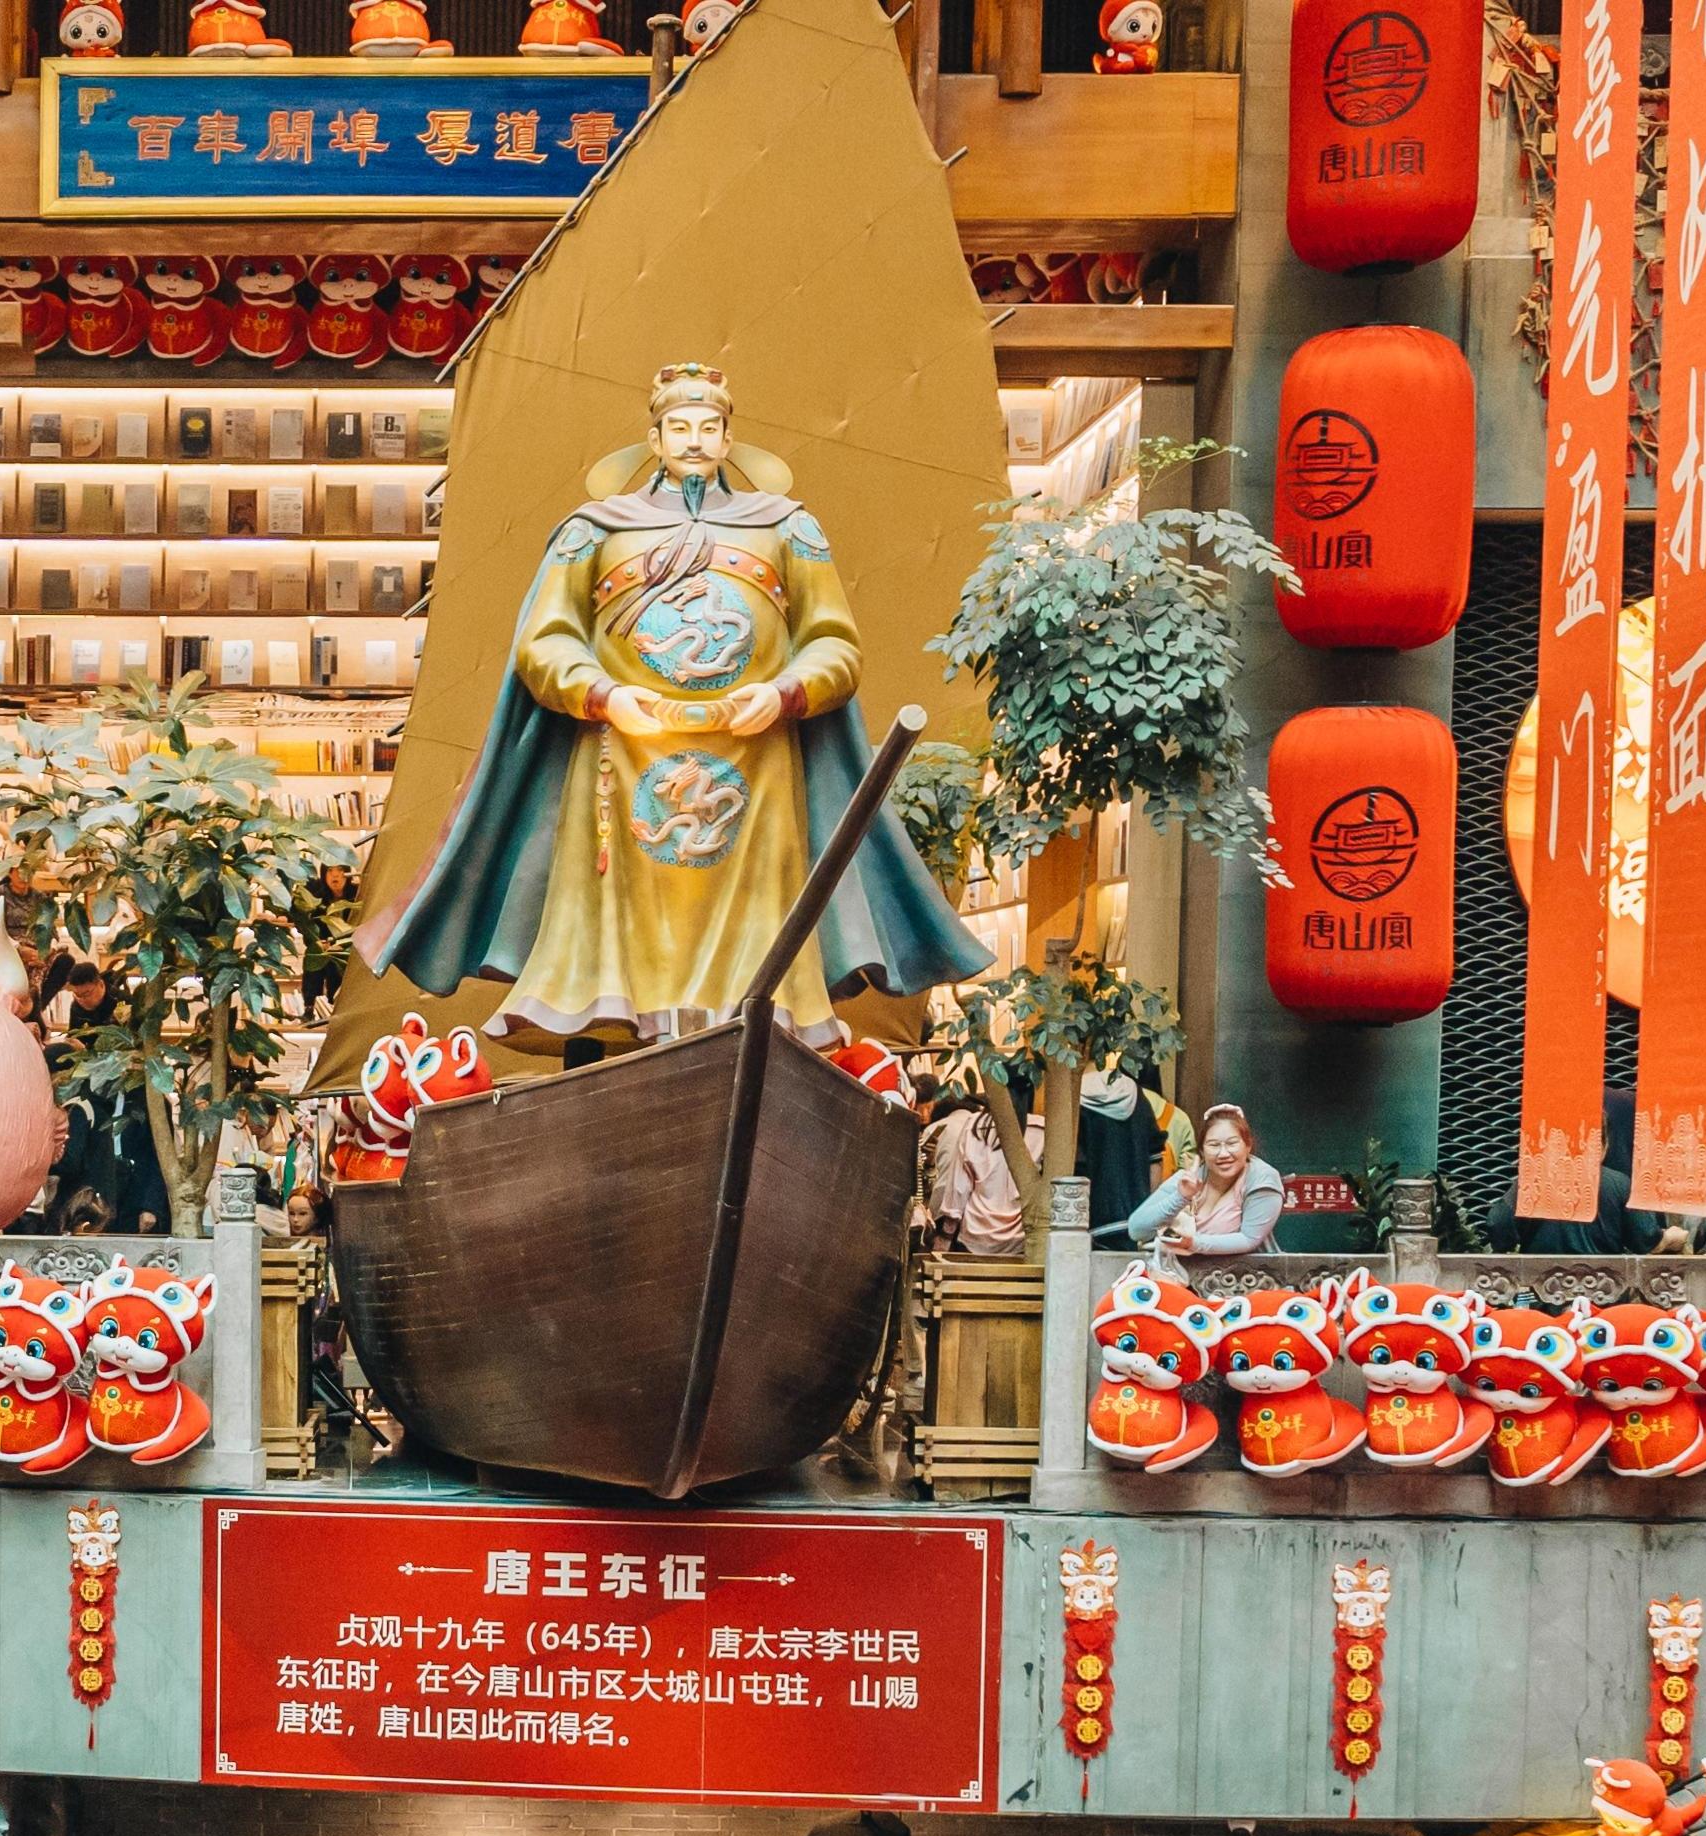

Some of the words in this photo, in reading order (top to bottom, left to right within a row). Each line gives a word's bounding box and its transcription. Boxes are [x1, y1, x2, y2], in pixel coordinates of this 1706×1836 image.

[127, 110, 622, 167] 百年開埠厚道唐
[483, 1549, 707, 1602] 唐王东征
[335, 1613, 921, 1665] 贞观十九年（645年），唐太宗李世民
[275, 1656, 919, 1712] 东征时，在今唐山市区大城山屯驻，山赐
[275, 1701, 632, 1748] 唐姓，唐山因此而得名。
